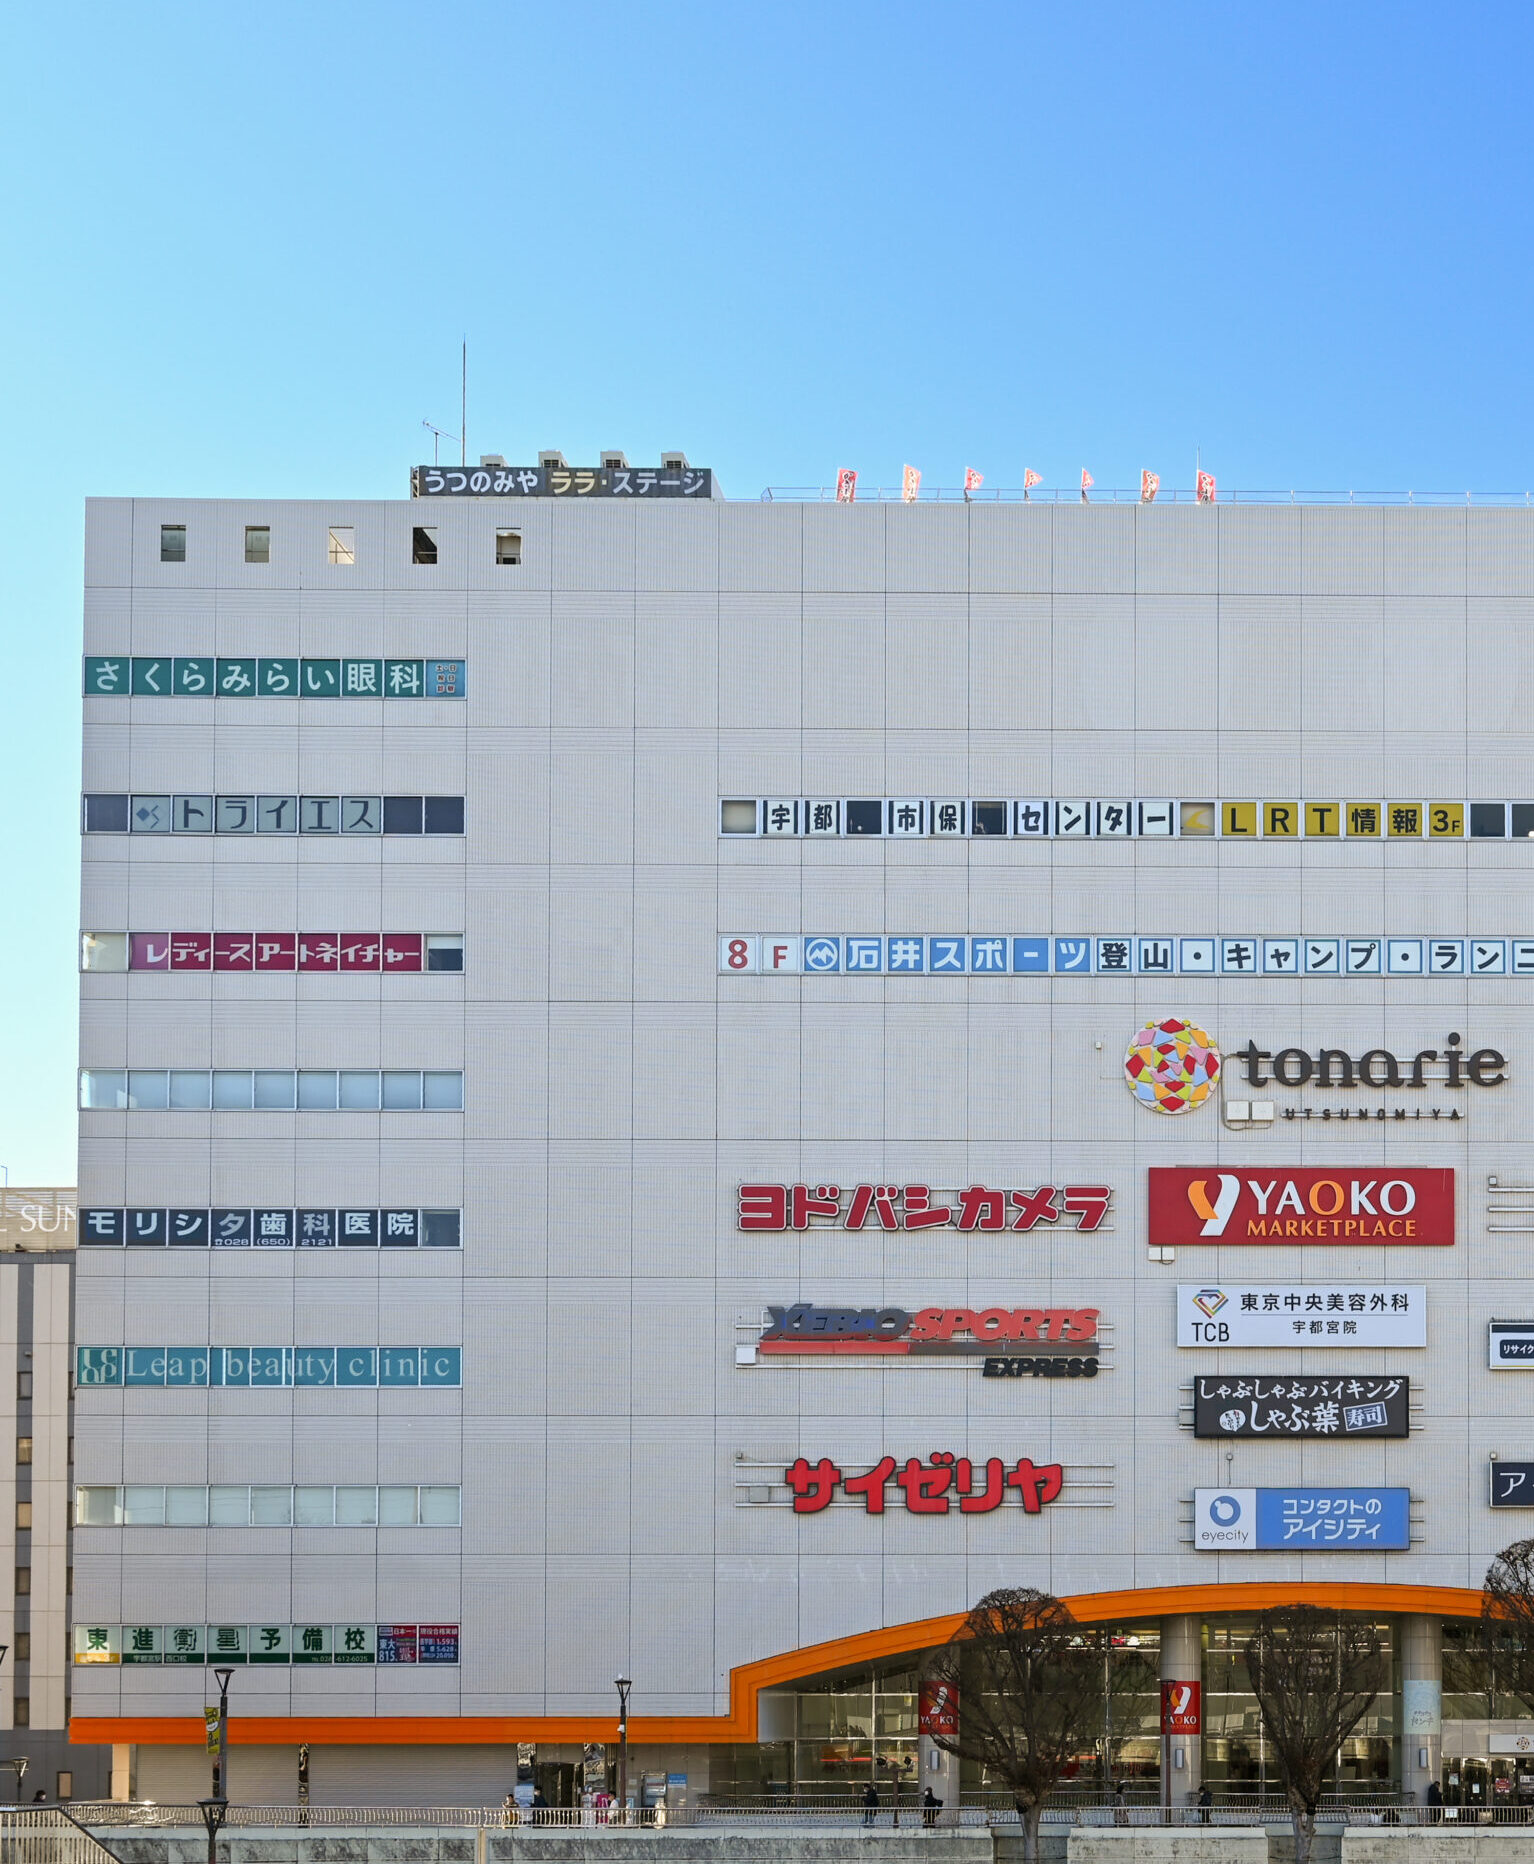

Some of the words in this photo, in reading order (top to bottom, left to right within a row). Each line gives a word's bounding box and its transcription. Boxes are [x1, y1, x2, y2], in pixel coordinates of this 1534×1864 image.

[425, 470, 538, 493] うつのみや
[550, 471, 704, 494] ララ・ステージ
[96, 662, 420, 694] さくらみらい眼科
[184, 800, 374, 829] トライエス
[147, 942, 420, 964] レディースアートネイチャー
[848, 938, 1086, 970] 石井スポーツ
[1237, 1031, 1505, 1088] tonarie
[1285, 1108, 1461, 1121] UTSUNOMIYA
[738, 1184, 1110, 1231] ヨドバシカメラ
[1247, 1180, 1416, 1216] YAOKO
[87, 1212, 419, 1236] モリシタ歯科医院
[1247, 1219, 1416, 1237] MARKETPLACE
[1240, 1293, 1409, 1312] 東京中央美容外科
[760, 1303, 910, 1341] XEBIO
[910, 1308, 1101, 1341] SPORTS
[1191, 1322, 1230, 1342] TCB
[1292, 1320, 1358, 1334] 宇都宮院
[128, 1350, 207, 1384] Leap
[226, 1349, 335, 1384] beauty
[348, 1349, 450, 1377] clinic
[983, 1357, 1099, 1378] EXPRESS
[1200, 1379, 1403, 1399] しゃぶしゃぶバイキング
[1250, 1400, 1340, 1433] しゃぶ葉
[1347, 1405, 1382, 1427] 寿司
[785, 1452, 1063, 1514] サイゼリヤ
[1283, 1498, 1382, 1515] コンタクトの
[1202, 1530, 1249, 1544] eyecity
[1283, 1518, 1382, 1540] アイシティ
[87, 1628, 365, 1651] 東進衛星予備校
